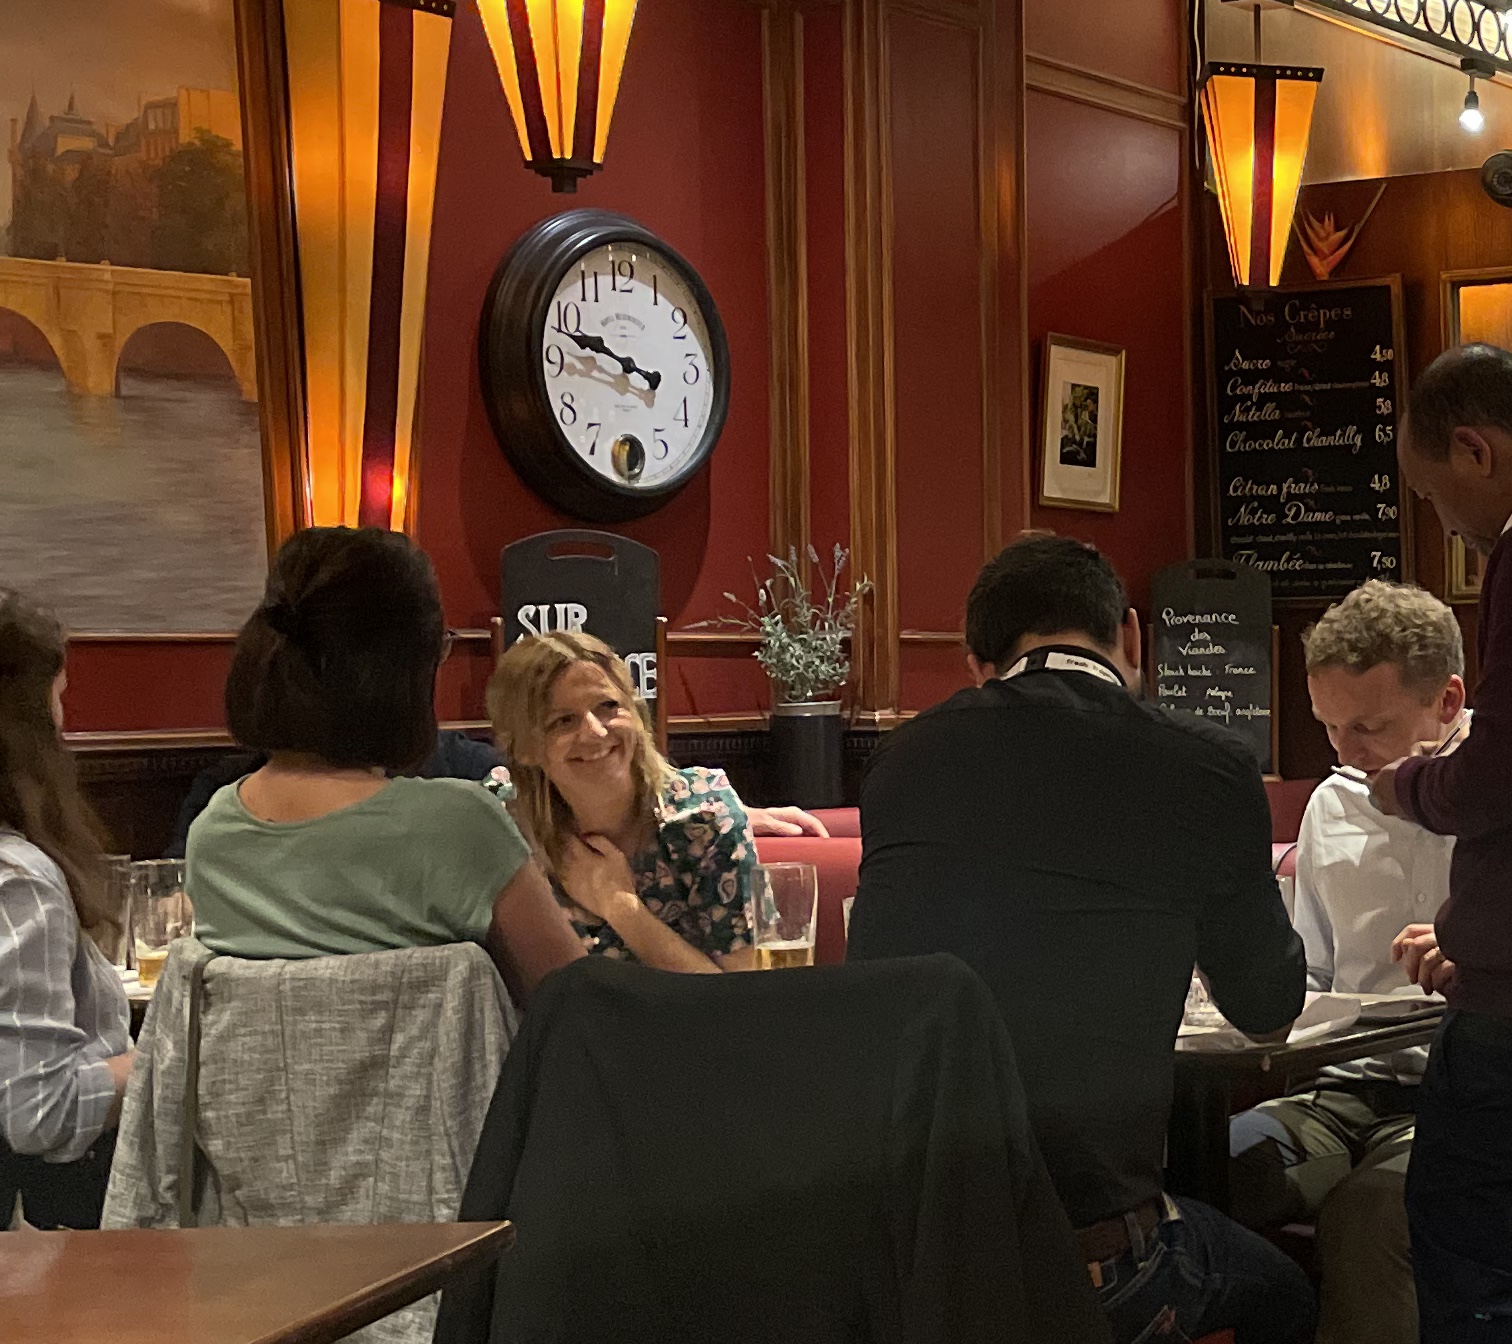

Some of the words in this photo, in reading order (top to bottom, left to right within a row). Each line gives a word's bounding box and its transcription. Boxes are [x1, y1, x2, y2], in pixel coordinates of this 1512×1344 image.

[580, 269, 600, 303] 11
[611, 259, 635, 293] 12
[652, 274, 660, 306] 1
[555, 301, 582, 335] 10
[671, 306, 688, 340] 2
[1237, 304, 1275, 327] Nos
[1285, 299, 1353, 328] Crêpes
[545, 343, 565, 378] 9
[682, 353, 701, 385] 3
[1224, 348, 1272, 371] Sucre
[1227, 376, 1294, 402] Confiture
[559, 391, 578, 426] 8
[673, 396, 690, 428] 4
[1224, 401, 1281, 423] Nutella
[586, 422, 602, 456] 7
[653, 428, 669, 460] 5
[1226, 429, 1298, 453] Chocolat
[1302, 425, 1363, 454] Chantilly
[1227, 476, 1278, 497] Citron
[1280, 477, 1319, 502] frais
[1227, 501, 1277, 526] Notre
[1282, 501, 1335, 524] Dame
[517, 603, 588, 644] SUR
[1162, 607, 1240, 627] Provenance
[1178, 642, 1226, 656] Viandes
[1190, 627, 1211, 642] des
